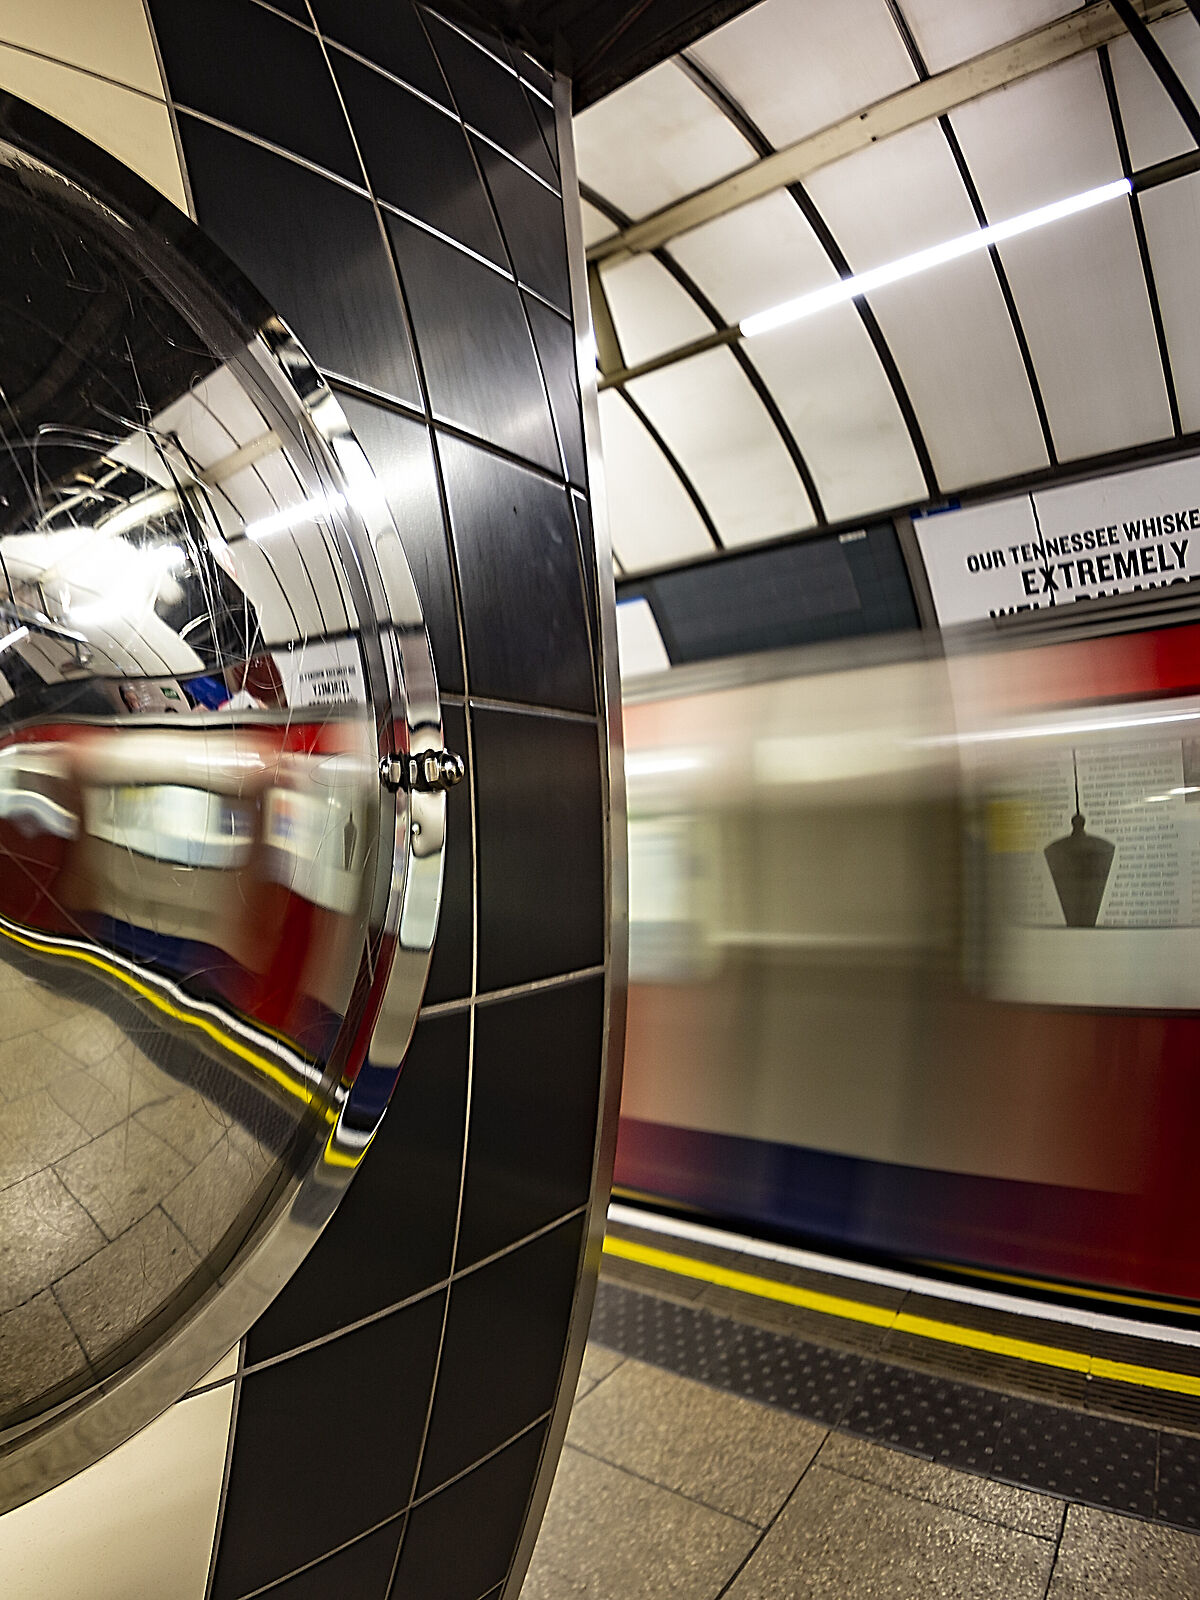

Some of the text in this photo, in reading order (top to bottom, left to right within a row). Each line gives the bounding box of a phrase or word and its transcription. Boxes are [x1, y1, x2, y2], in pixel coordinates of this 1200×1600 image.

[967, 508, 1200, 573] OUR TENNESSEE WHISKE
[1021, 539, 1189, 596] EXTREMELY
